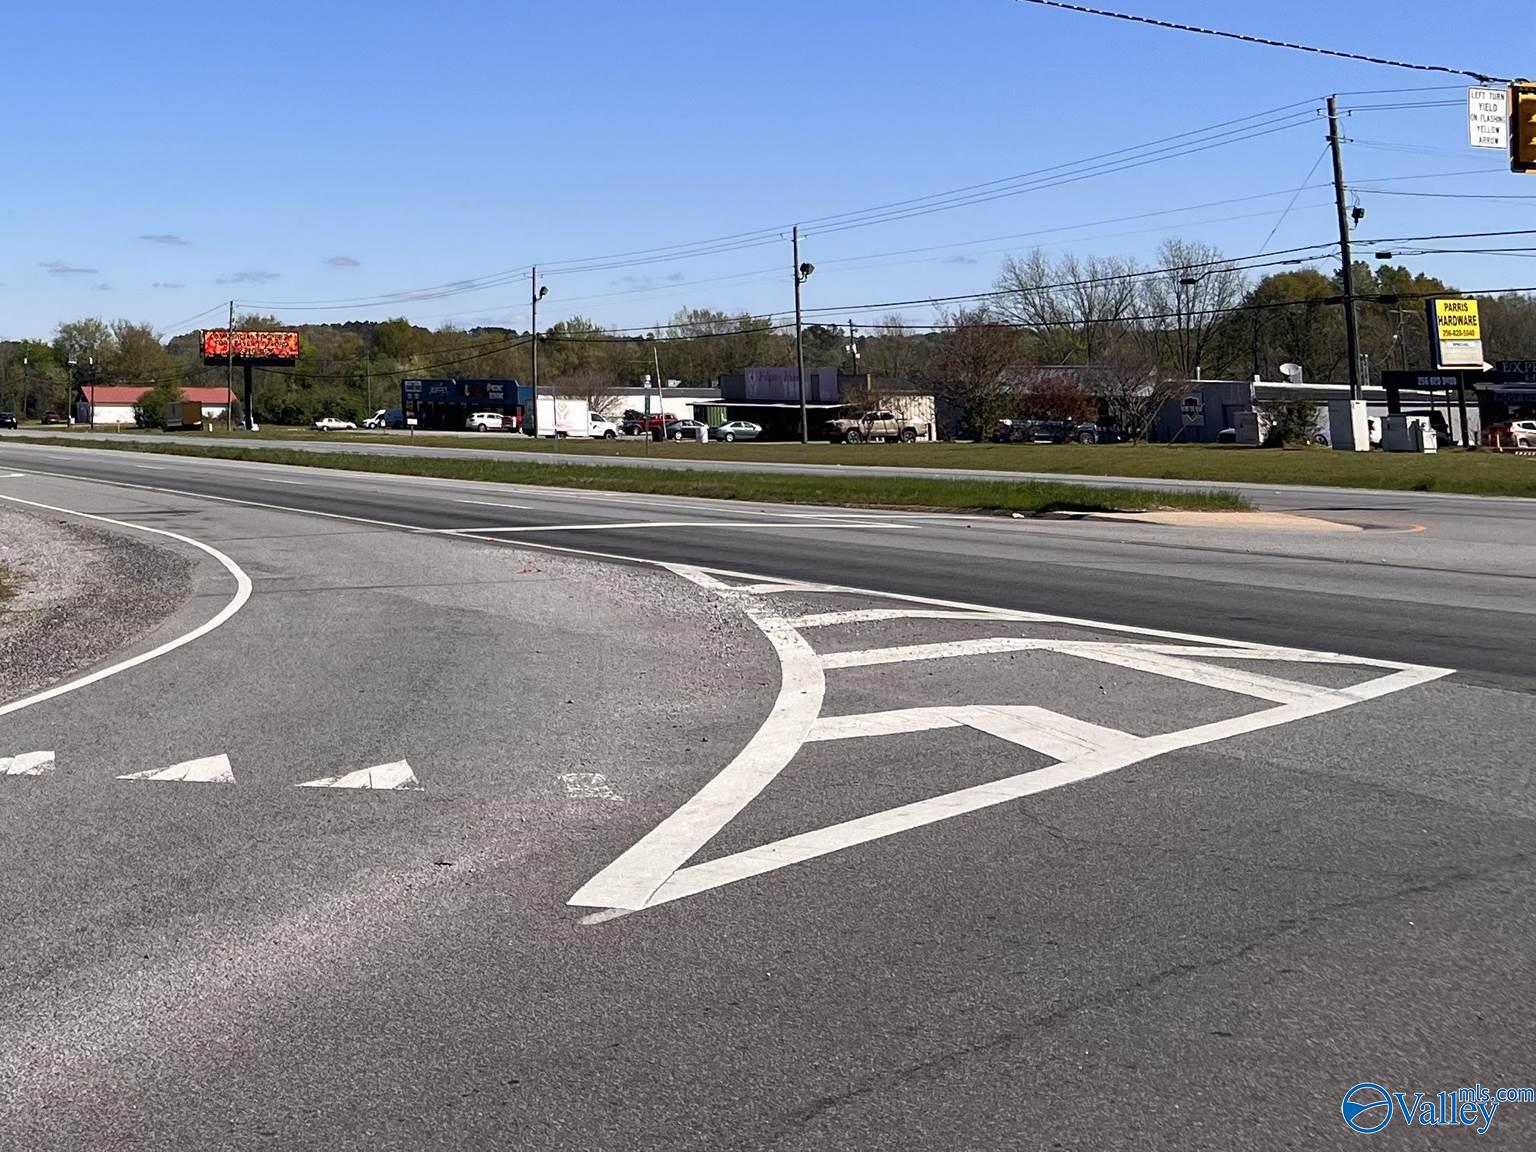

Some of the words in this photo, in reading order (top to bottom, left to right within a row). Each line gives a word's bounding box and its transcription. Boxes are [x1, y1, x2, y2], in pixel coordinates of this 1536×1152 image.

[1471, 91, 1485, 99] LEFT
[1489, 92, 1505, 100] TURN
[1479, 103, 1498, 112] YIELD
[1476, 126, 1500, 134] YELLOW
[1478, 136, 1499, 144] ARROW
[1444, 302, 1469, 312] PARRIS
[1438, 315, 1478, 326] HARDWARE
